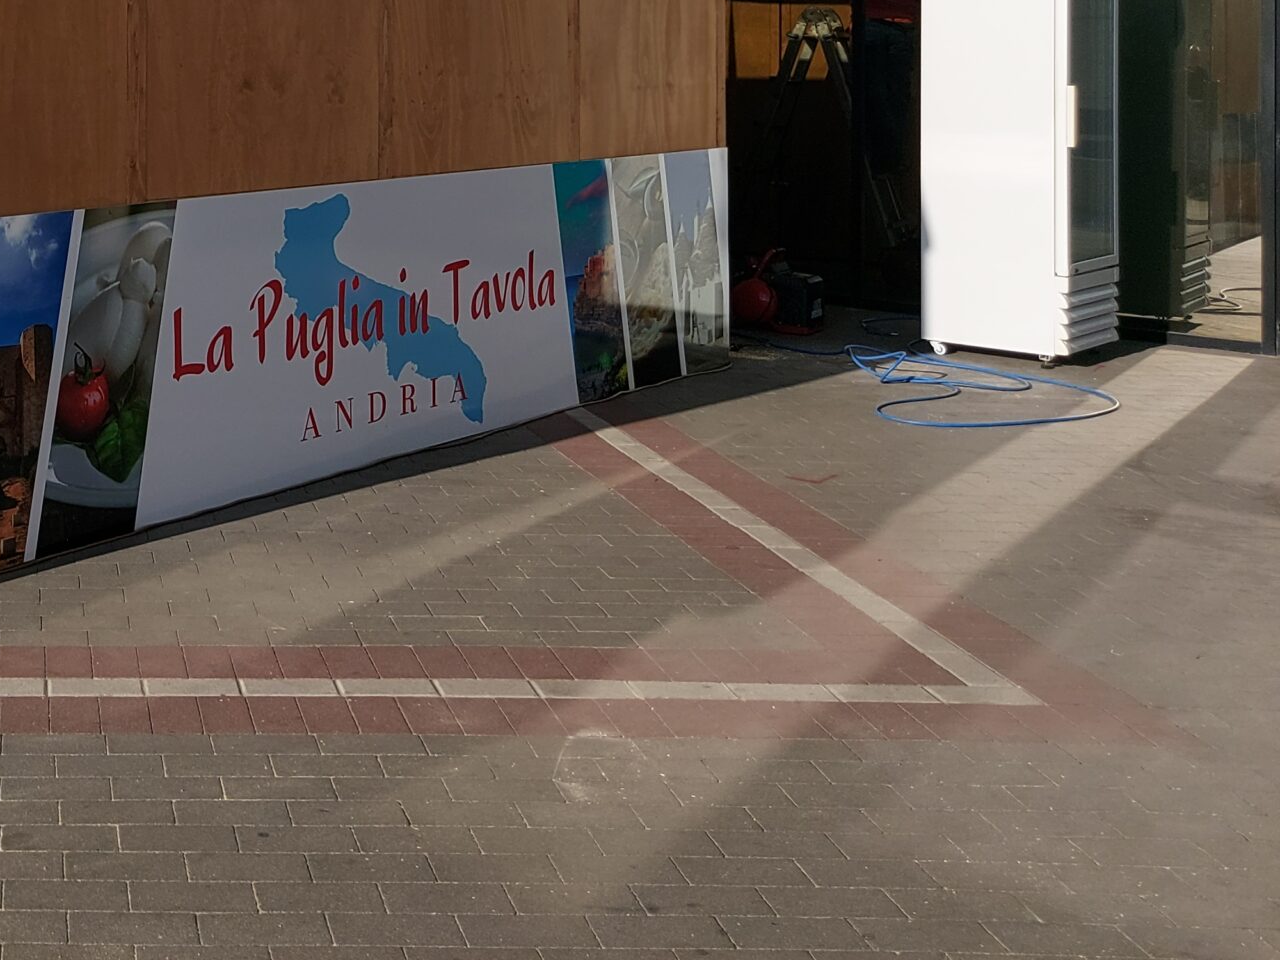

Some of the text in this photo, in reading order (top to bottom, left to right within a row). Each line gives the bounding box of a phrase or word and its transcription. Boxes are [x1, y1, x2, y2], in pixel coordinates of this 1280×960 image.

[172, 249, 556, 386] La Puglia in Tavola
[300, 371, 468, 442] ANDRIA
